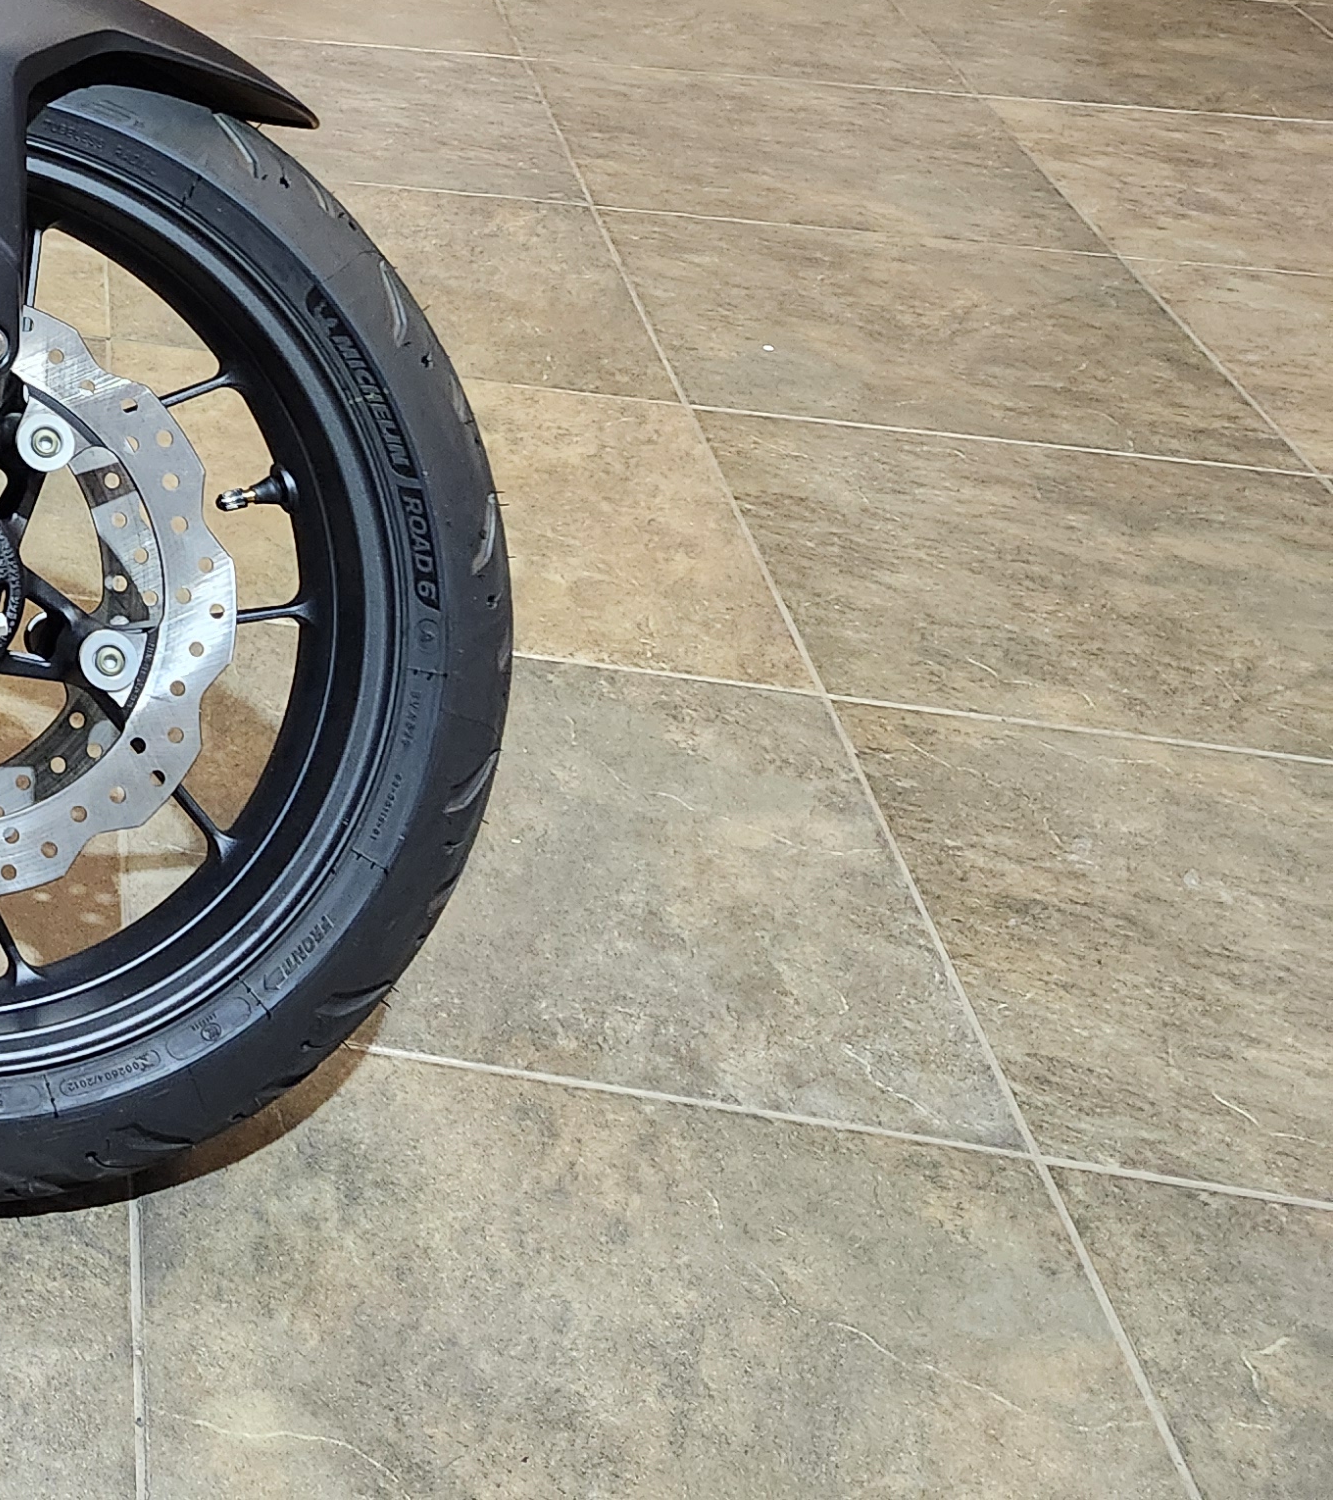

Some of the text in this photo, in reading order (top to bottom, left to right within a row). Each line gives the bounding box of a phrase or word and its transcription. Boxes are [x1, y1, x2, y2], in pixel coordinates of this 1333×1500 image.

[335, 334, 440, 599] MICHELIN ROAD 6
